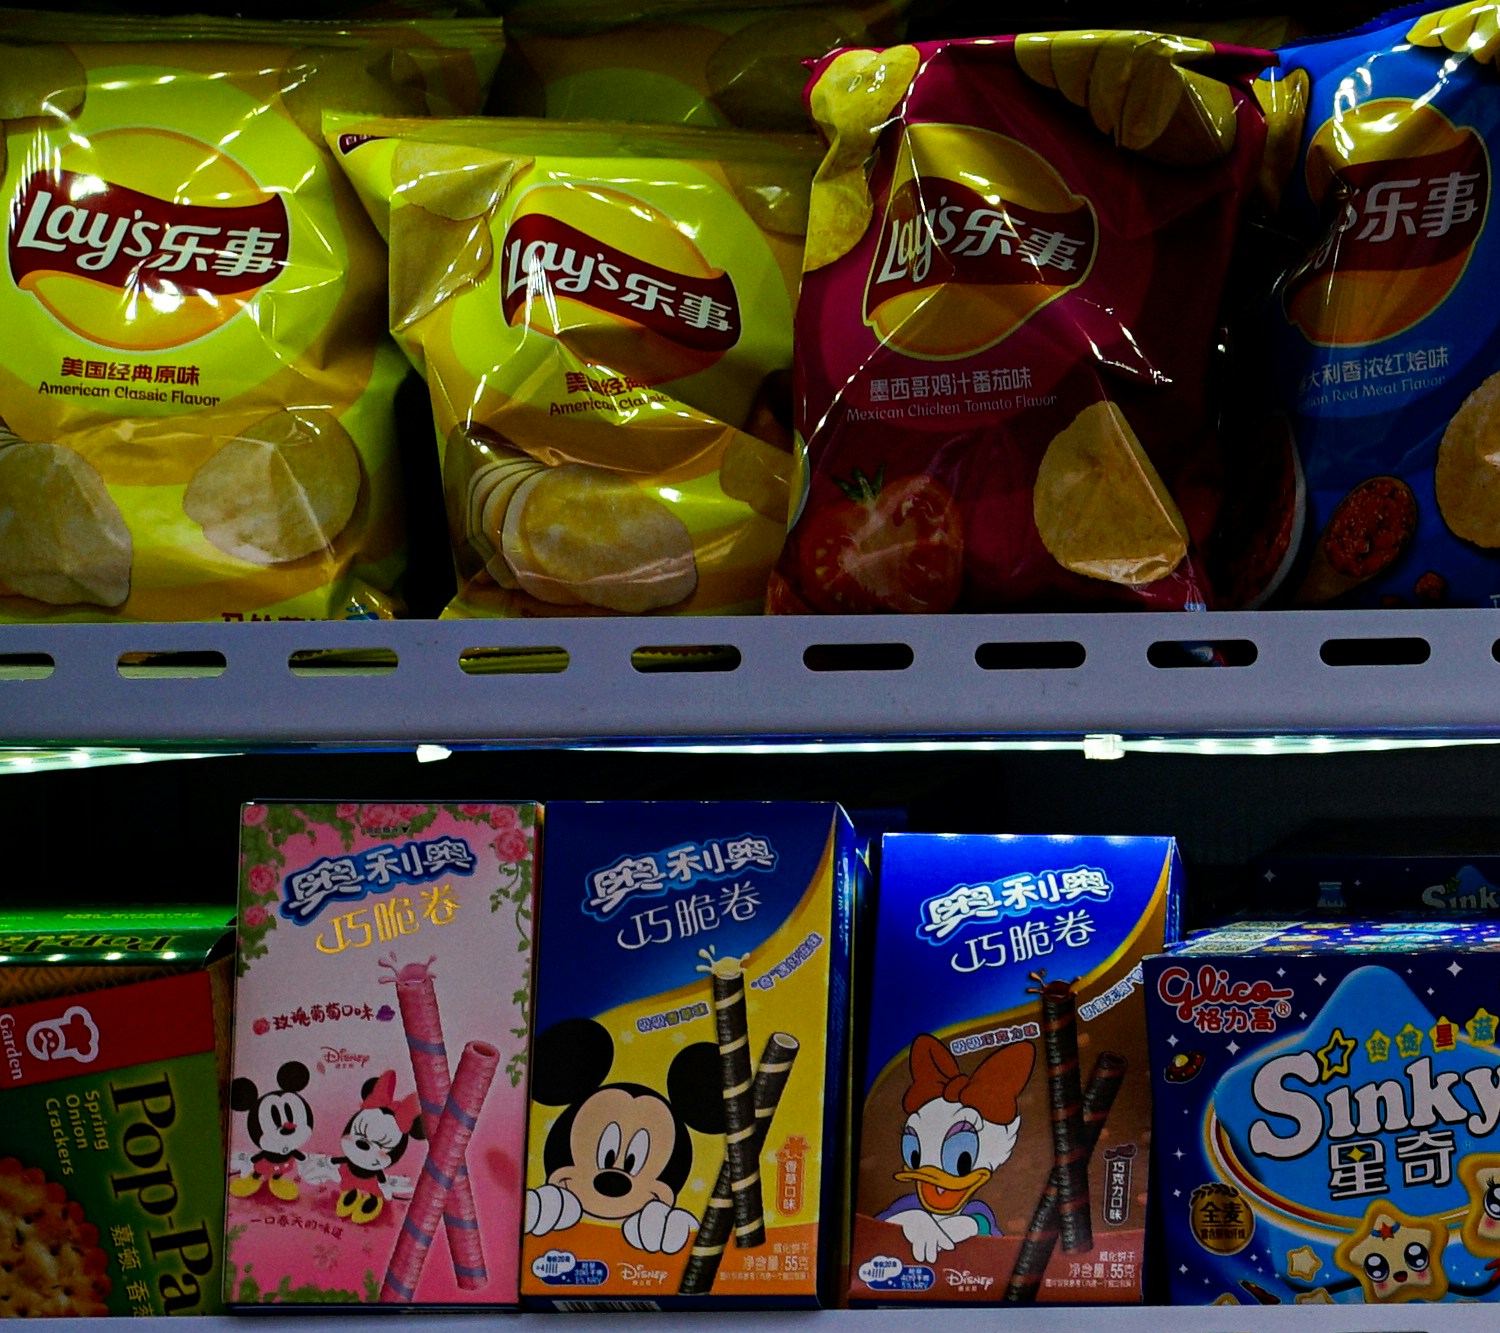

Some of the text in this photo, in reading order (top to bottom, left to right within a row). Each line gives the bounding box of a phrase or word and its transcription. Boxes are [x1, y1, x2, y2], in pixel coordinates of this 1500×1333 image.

[17, 191, 277, 279] Lay's乐事
[877, 197, 1086, 283] Lay's乐事
[38, 380, 220, 408] American Classic Flavor
[60, 357, 201, 388] 美国经典原味
[869, 366, 1032, 402] 墨西哥鸡汁番茄味
[846, 395, 1057, 423] Mexican Chicken Tomato Flavor
[292, 838, 475, 915] 奥利奥
[587, 836, 777, 915] 奥利奥
[315, 883, 462, 954] 巧脆卷
[273, 1003, 374, 1032] 玫瑰葡萄口味
[1196, 1005, 1277, 1033] 格力高
[44, 1098, 76, 1176] Crackers
[65, 1095, 88, 1150] Onion
[83, 1091, 111, 1150] Spring
[1108, 1160, 1126, 1223] 巧克力口味
[1328, 1130, 1456, 1201] 星奇
[1200, 1200, 1244, 1226] 全麦
